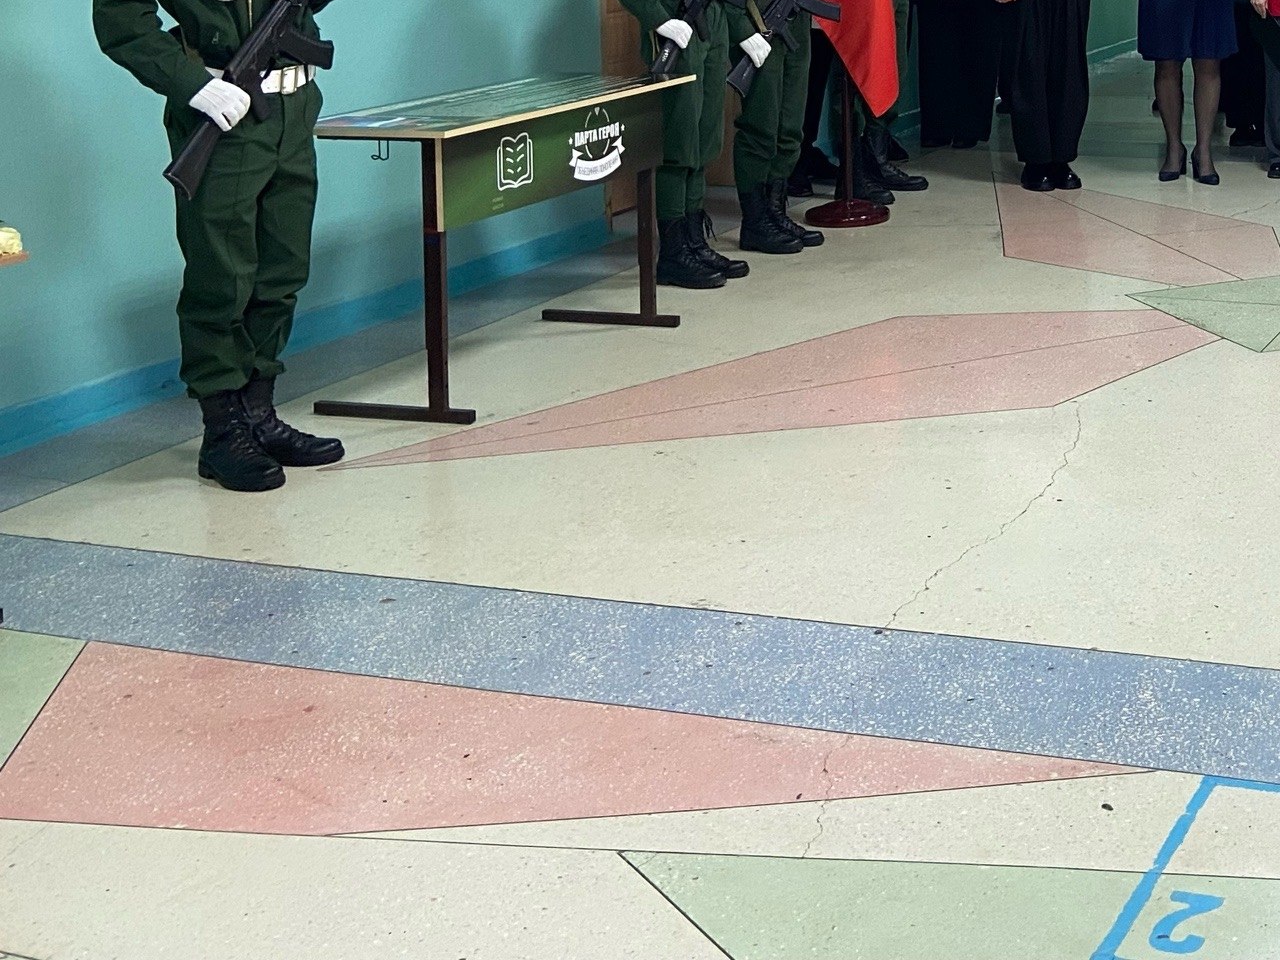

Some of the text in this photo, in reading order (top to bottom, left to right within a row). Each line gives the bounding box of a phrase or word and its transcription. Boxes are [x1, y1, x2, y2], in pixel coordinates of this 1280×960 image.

[574, 122, 620, 147] ПАРТА ГЕРОЯ
[1148, 890, 1226, 955] 2
